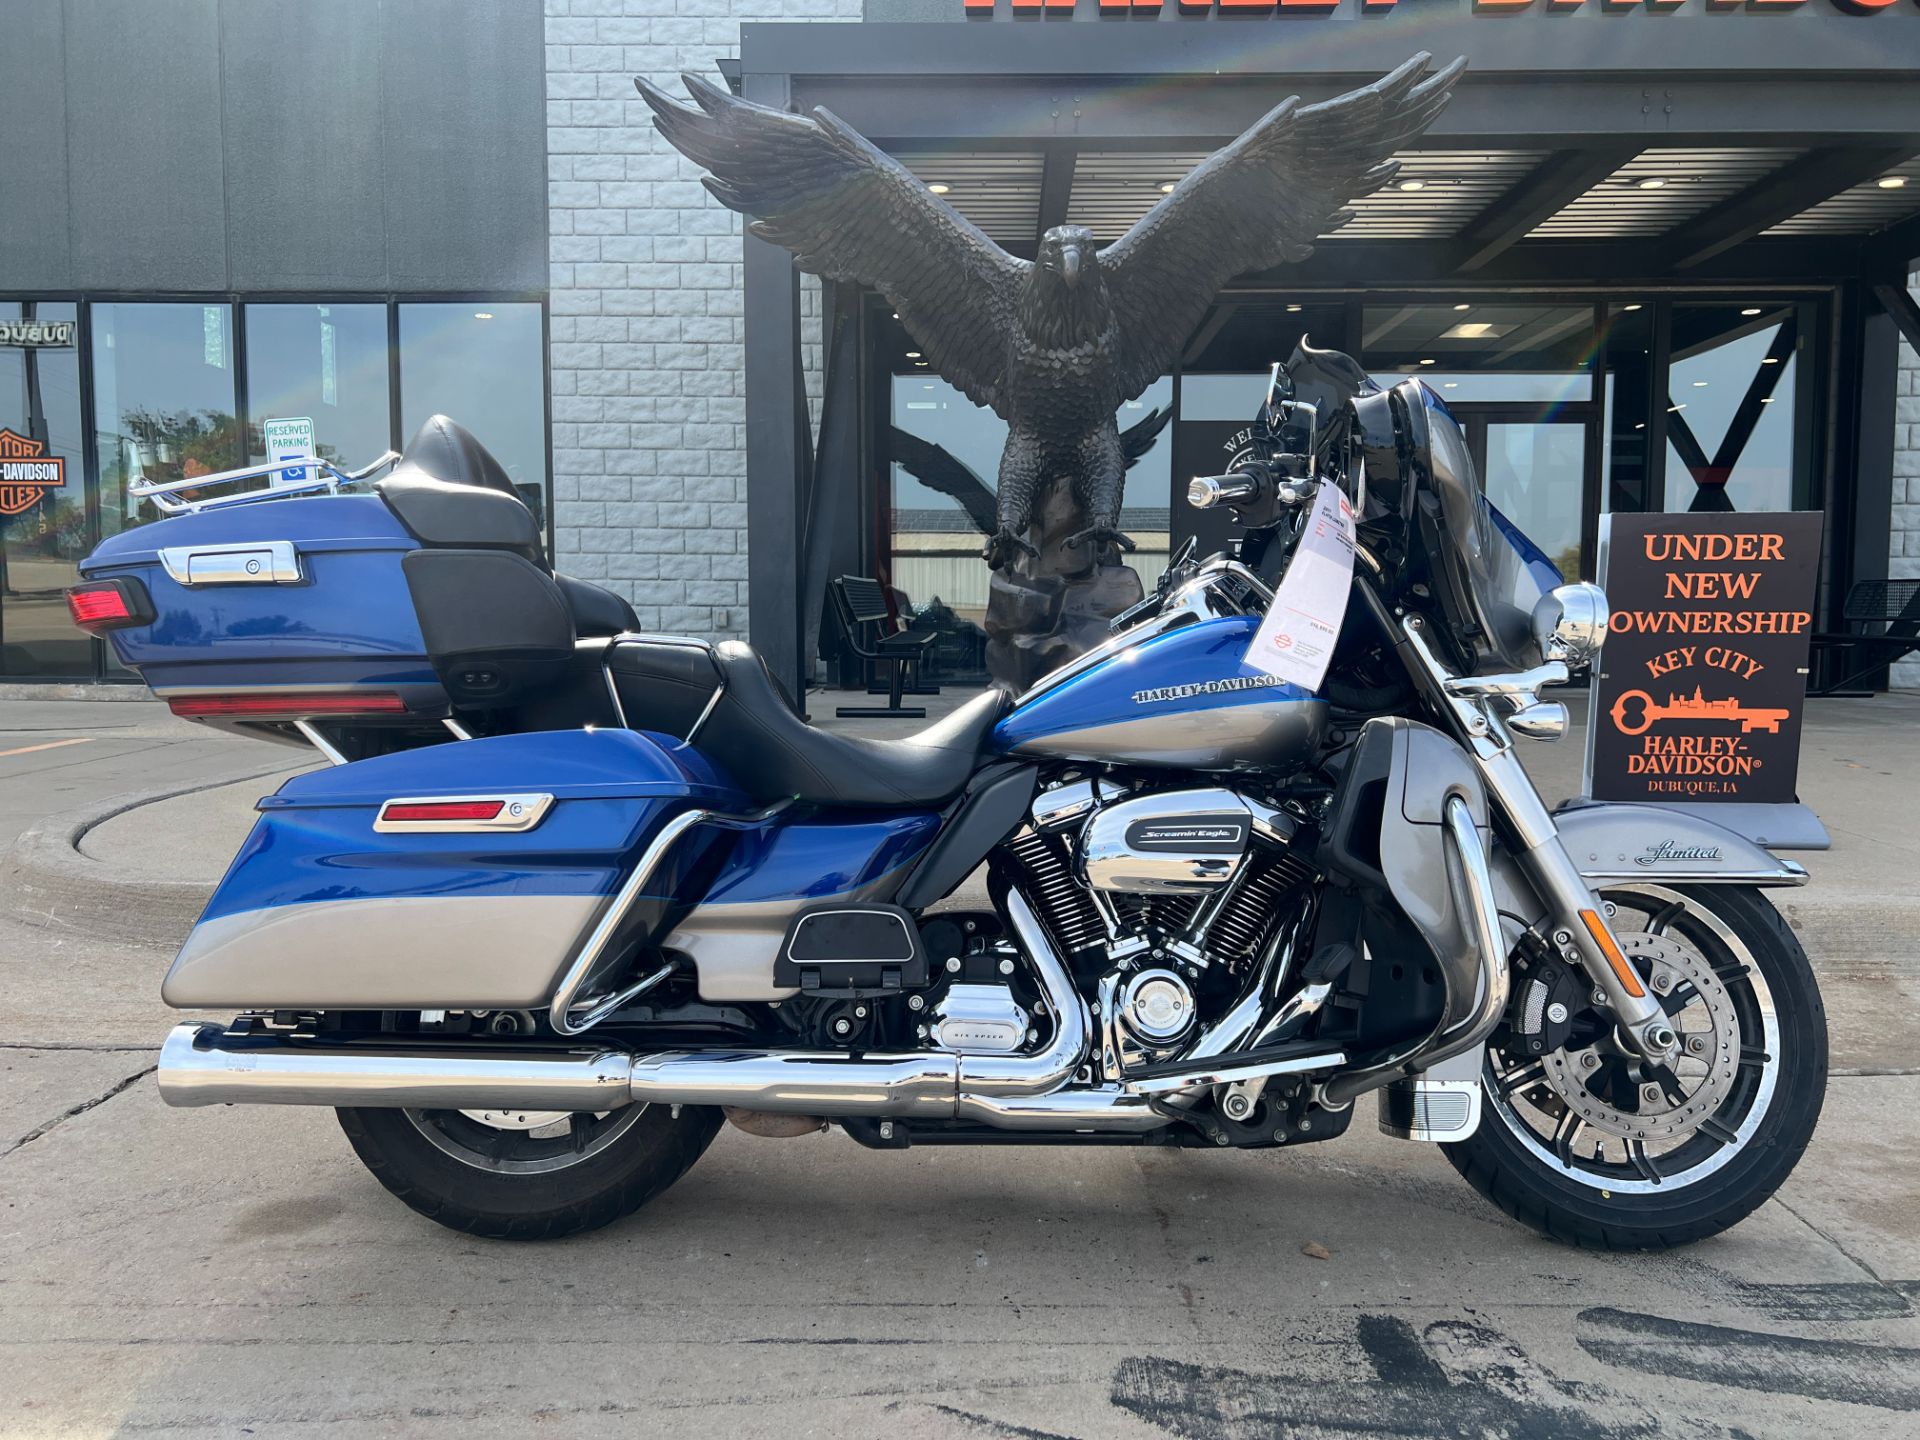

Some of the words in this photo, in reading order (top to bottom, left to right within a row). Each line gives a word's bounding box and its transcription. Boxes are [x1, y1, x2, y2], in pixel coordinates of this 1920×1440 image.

[268, 425, 310, 436] RESERVED
[0, 436, 33, 457] TOR
[272, 437, 309, 448] PARKING
[1643, 533, 1786, 561] UNDER
[1664, 573, 1762, 599] NEW
[1609, 611, 1812, 634] OWNERSHIP
[1645, 646, 1697, 679] KEY
[1704, 647, 1765, 681] CITY
[1643, 736, 1748, 756] HARLEY-
[1648, 781, 1720, 796] DUBUQUE,
[1723, 783, 1738, 793] IA
[1198, 829, 1231, 838] Eagle
[1634, 840, 1724, 867] Limited
